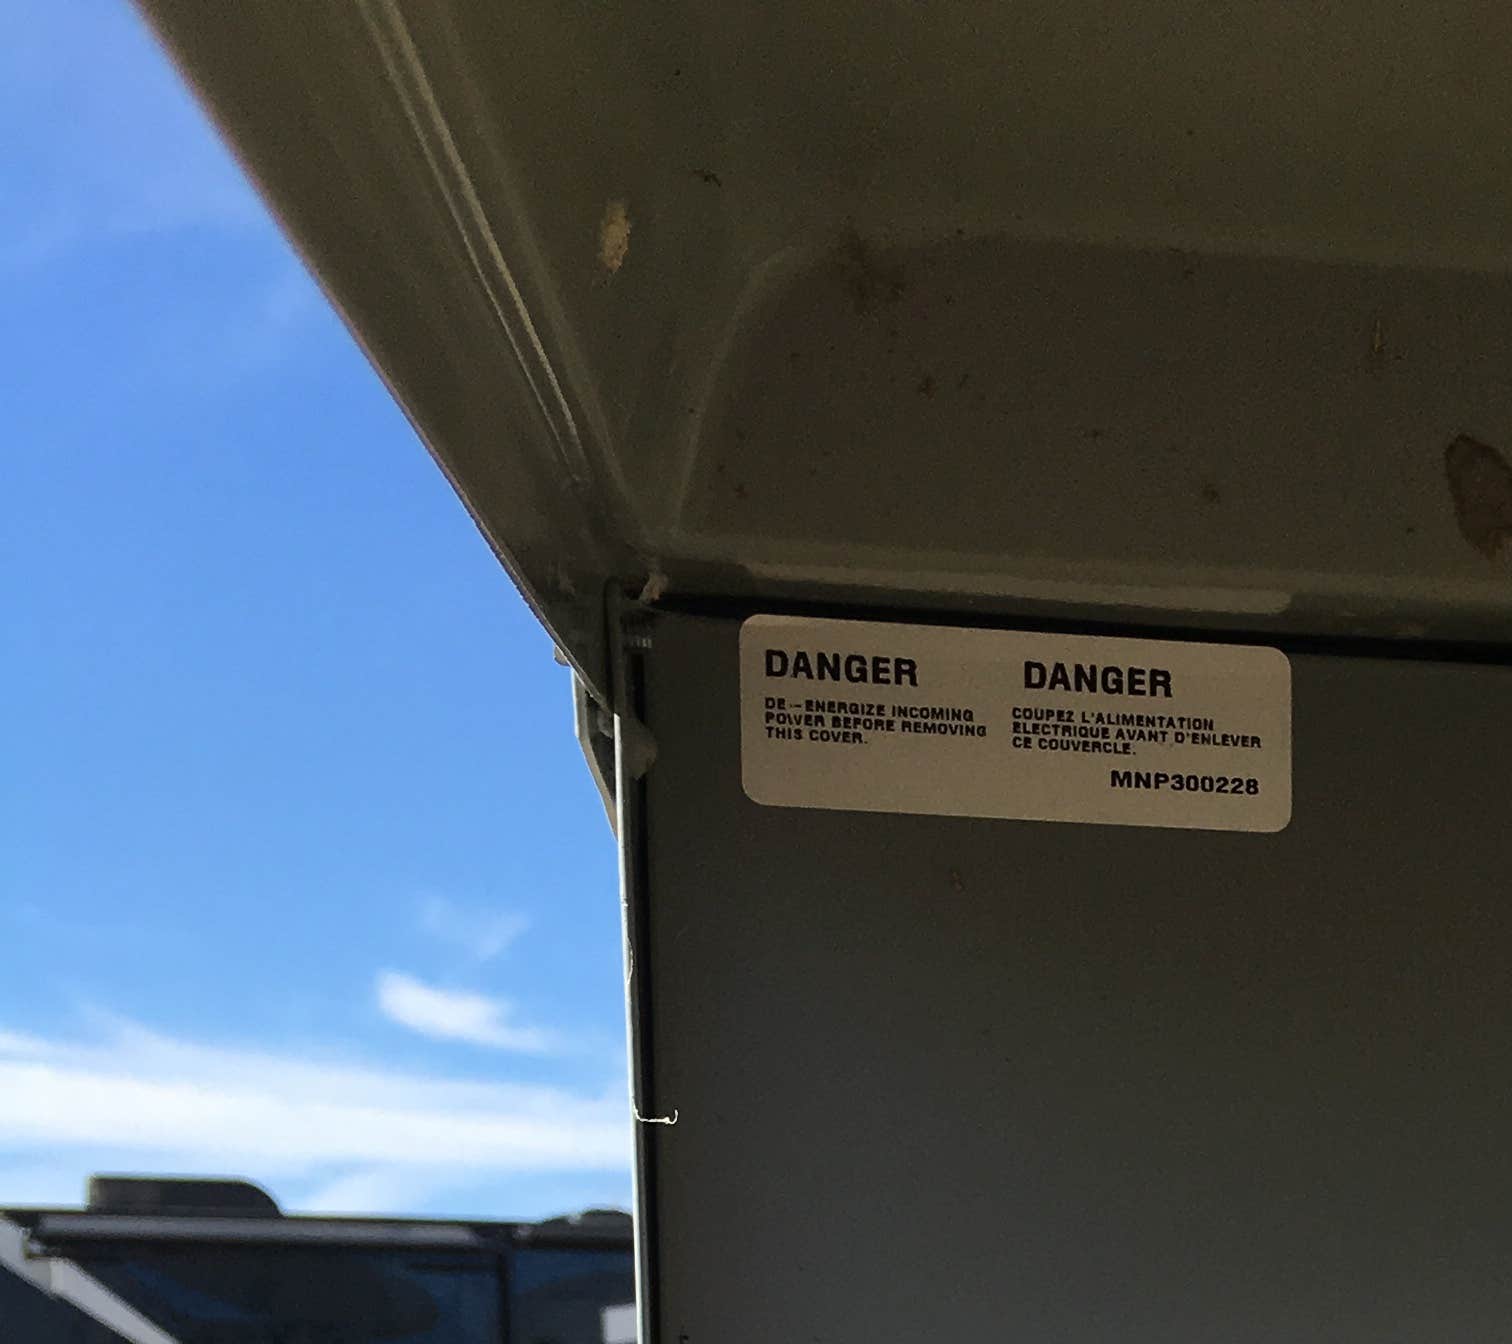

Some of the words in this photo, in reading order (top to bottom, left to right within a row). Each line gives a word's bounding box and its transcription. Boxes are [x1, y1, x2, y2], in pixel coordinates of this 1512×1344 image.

[766, 649, 918, 687] DANGER
[1024, 661, 1172, 697] DANGER
[765, 711, 824, 731] POWER
[832, 716, 895, 731] BEFORE
[902, 720, 986, 737] REMOVING
[892, 705, 973, 722] INCOMING
[1012, 707, 1074, 722] COUPEZ
[1079, 712, 1213, 733] L'ALIMENTATION
[766, 726, 802, 740] THIS
[809, 730, 867, 744] COVER.
[1012, 721, 1109, 741] ELECTRIQUE
[1116, 728, 1168, 742] AVANT
[1175, 732, 1261, 748] D'ENLEVER
[1013, 736, 1032, 749] CE
[1038, 738, 1136, 755] COUVERCLE.
[1111, 770, 1258, 795] MNP300228
